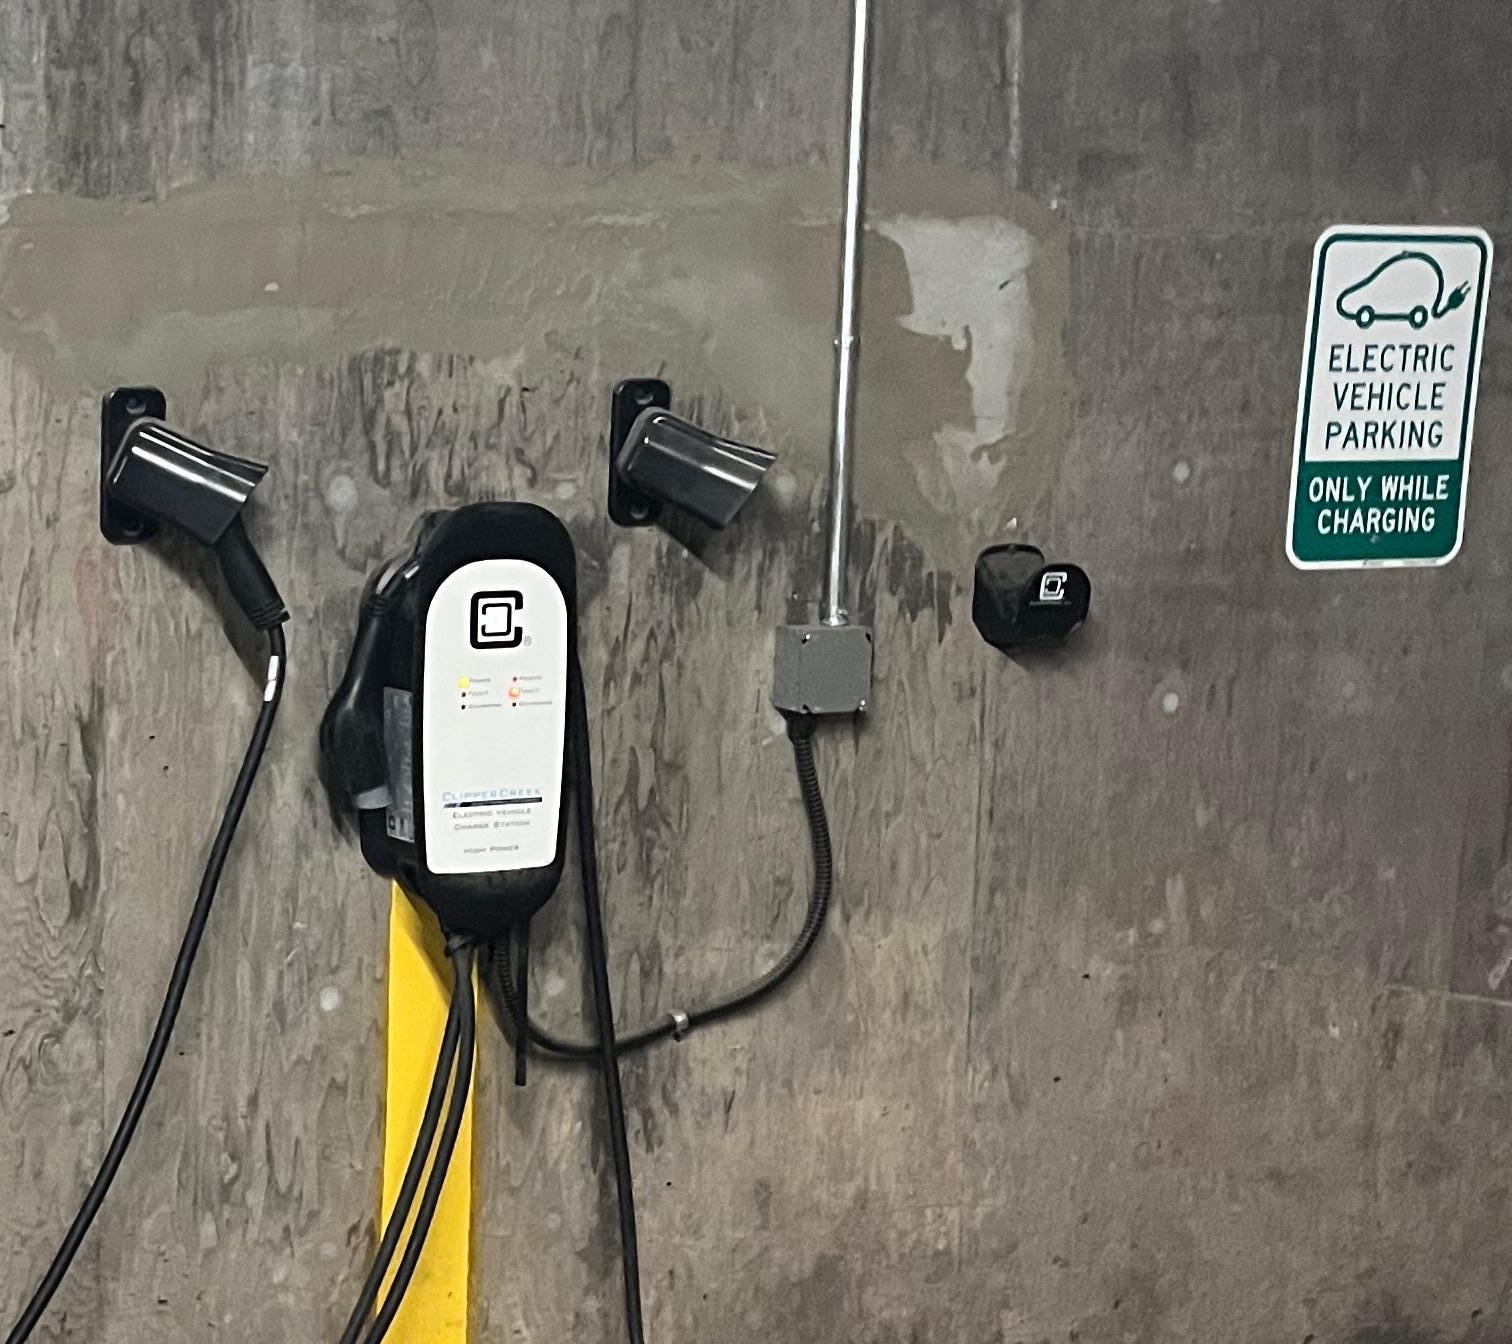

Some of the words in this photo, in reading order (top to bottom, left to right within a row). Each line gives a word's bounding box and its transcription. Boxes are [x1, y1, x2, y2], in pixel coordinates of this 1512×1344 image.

[1328, 343, 1456, 374] ELECTRIC
[1332, 381, 1447, 412] VEHICLE
[1324, 420, 1444, 451] PARKING
[1308, 475, 1373, 504] ONLY
[1380, 473, 1450, 503] WHILE
[1316, 506, 1437, 536] CHARGING
